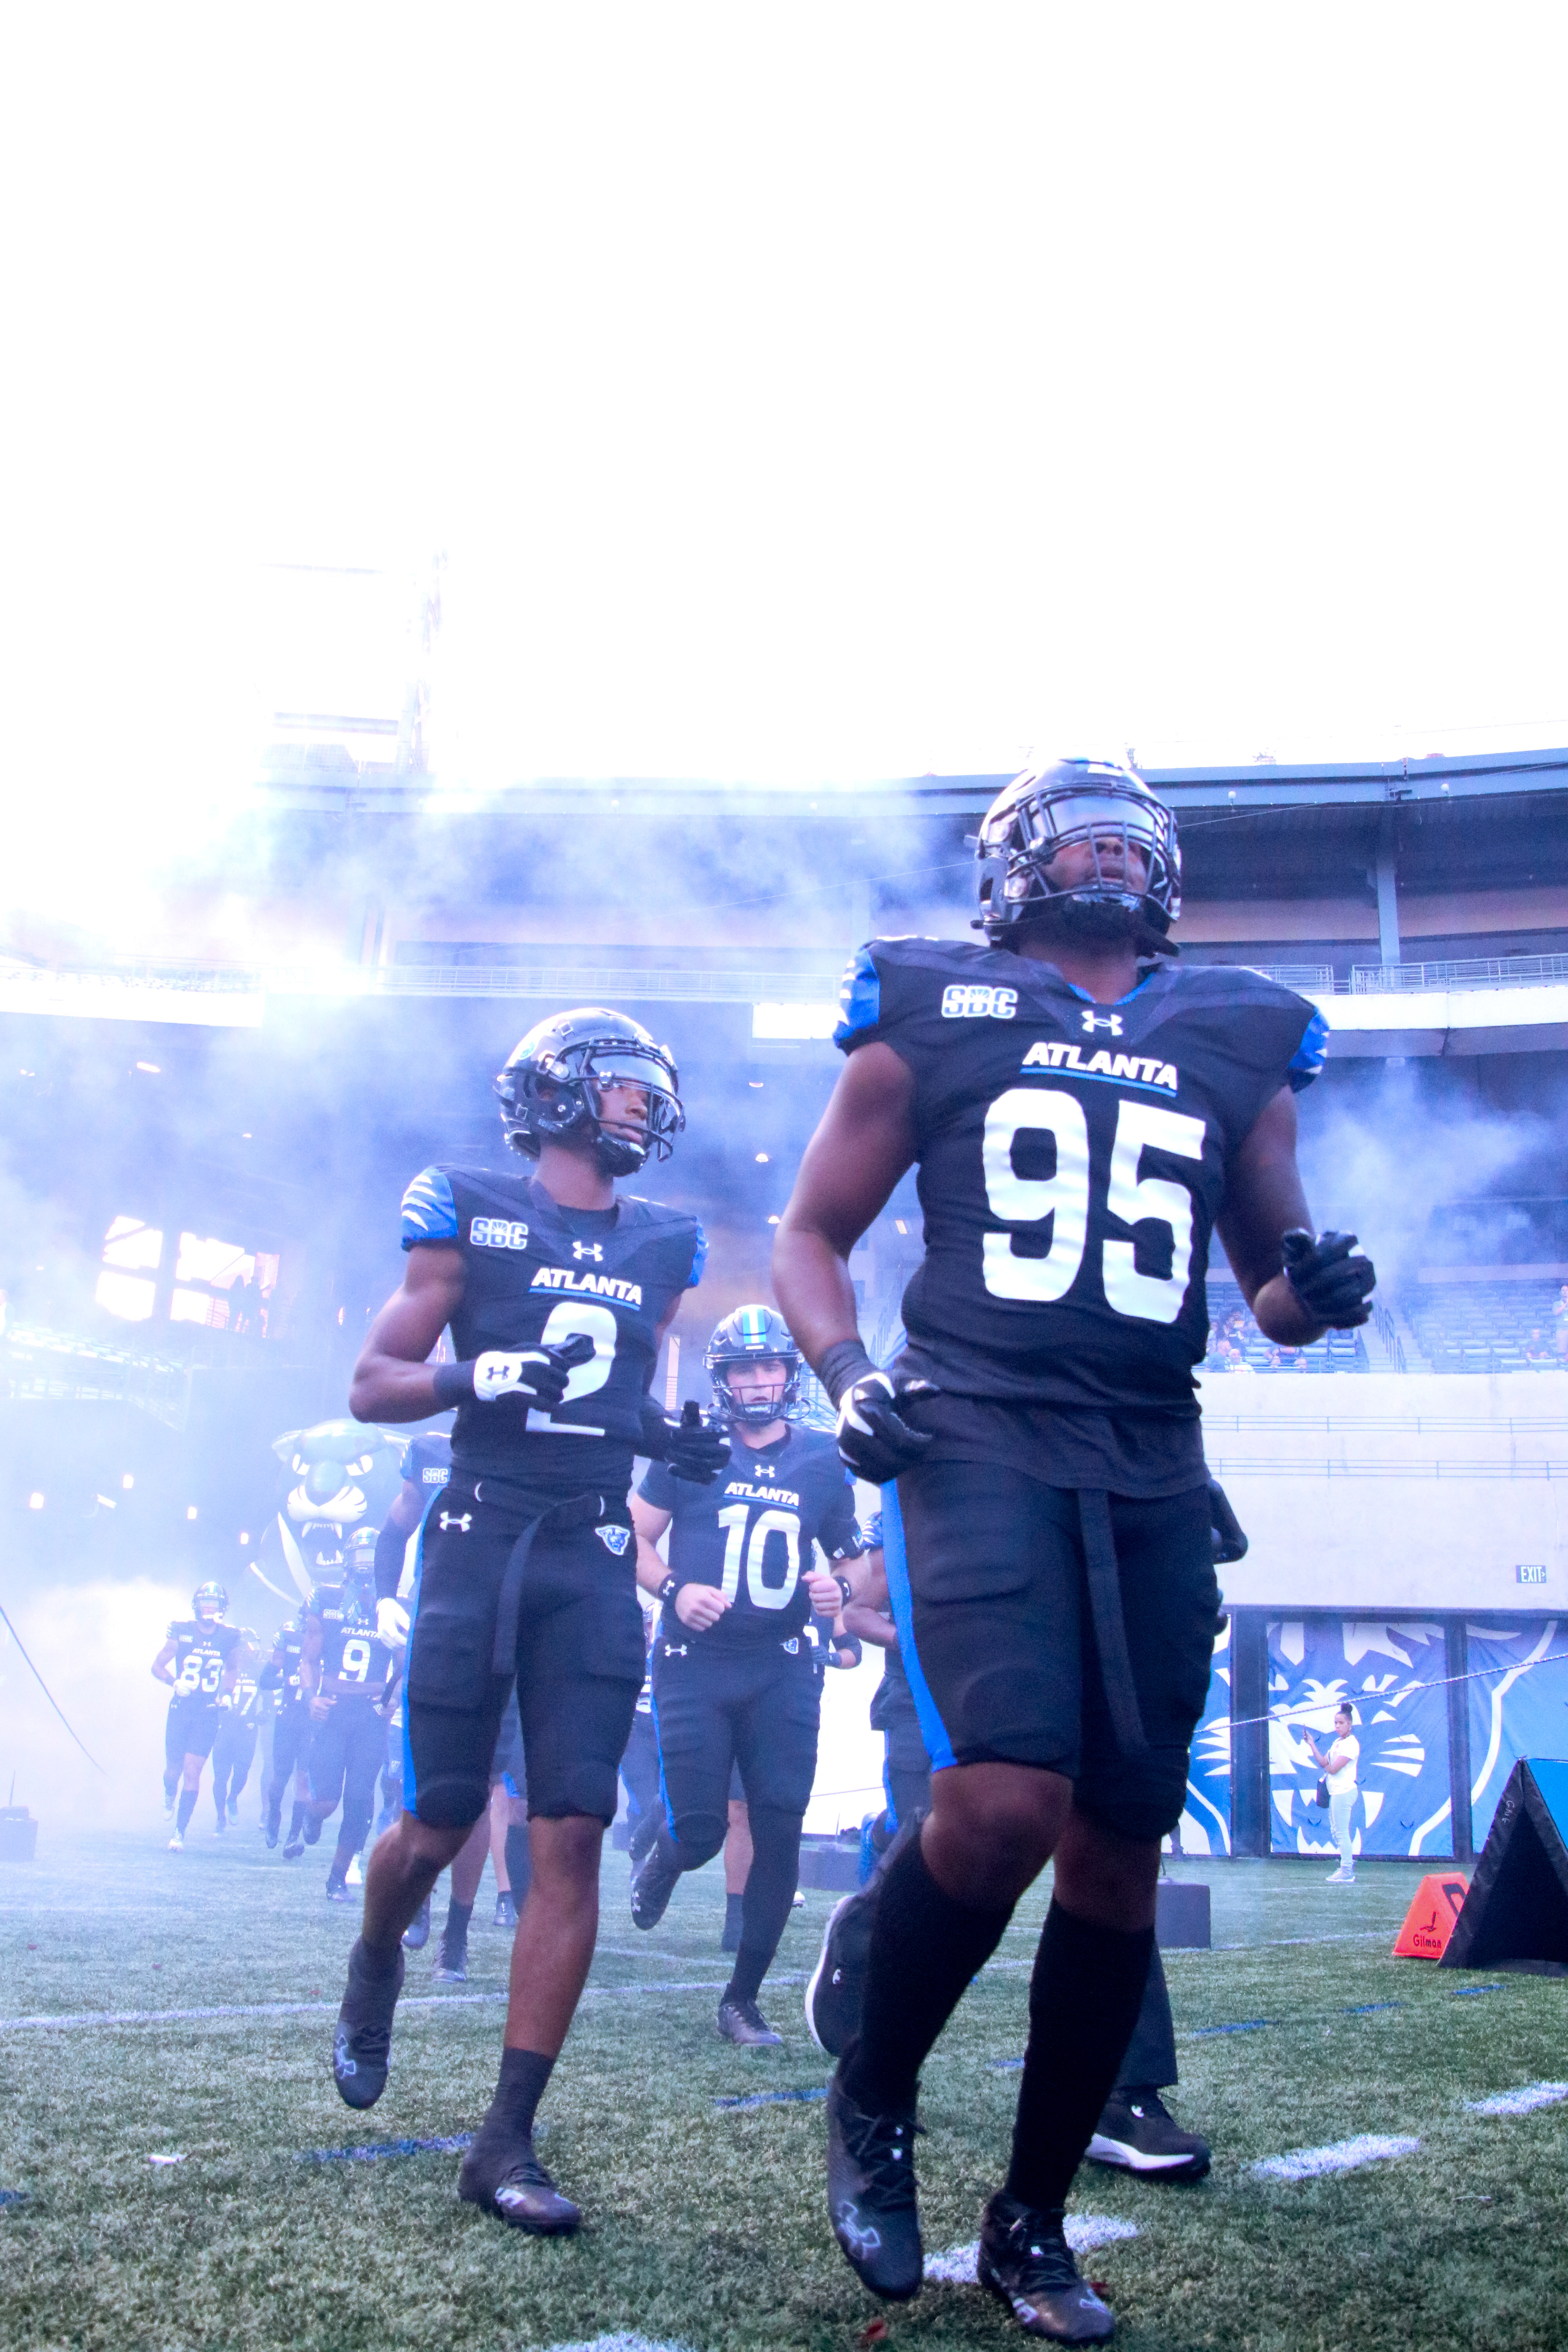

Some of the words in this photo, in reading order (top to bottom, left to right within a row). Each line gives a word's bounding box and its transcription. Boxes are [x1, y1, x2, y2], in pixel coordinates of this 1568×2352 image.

[941, 984, 1018, 1019] SBC
[1021, 1042, 1178, 1090] ATLANTA
[982, 1088, 1206, 1324] 95
[470, 1217, 528, 1250] SBC
[531, 1268, 641, 1305] ATLANTA
[526, 1302, 617, 1437] 2
[423, 1468, 448, 1483] SBC
[724, 1482, 799, 1506] ATLANTA
[718, 1504, 801, 1610] 10
[1521, 1566, 1542, 1582] EXIT
[192, 1648, 221, 1657] ATLANTA
[338, 1639, 370, 1682] 9
[180, 1655, 224, 1692] 83
[232, 1685, 258, 1715] 17
[1413, 1934, 1441, 1949] Gilman
